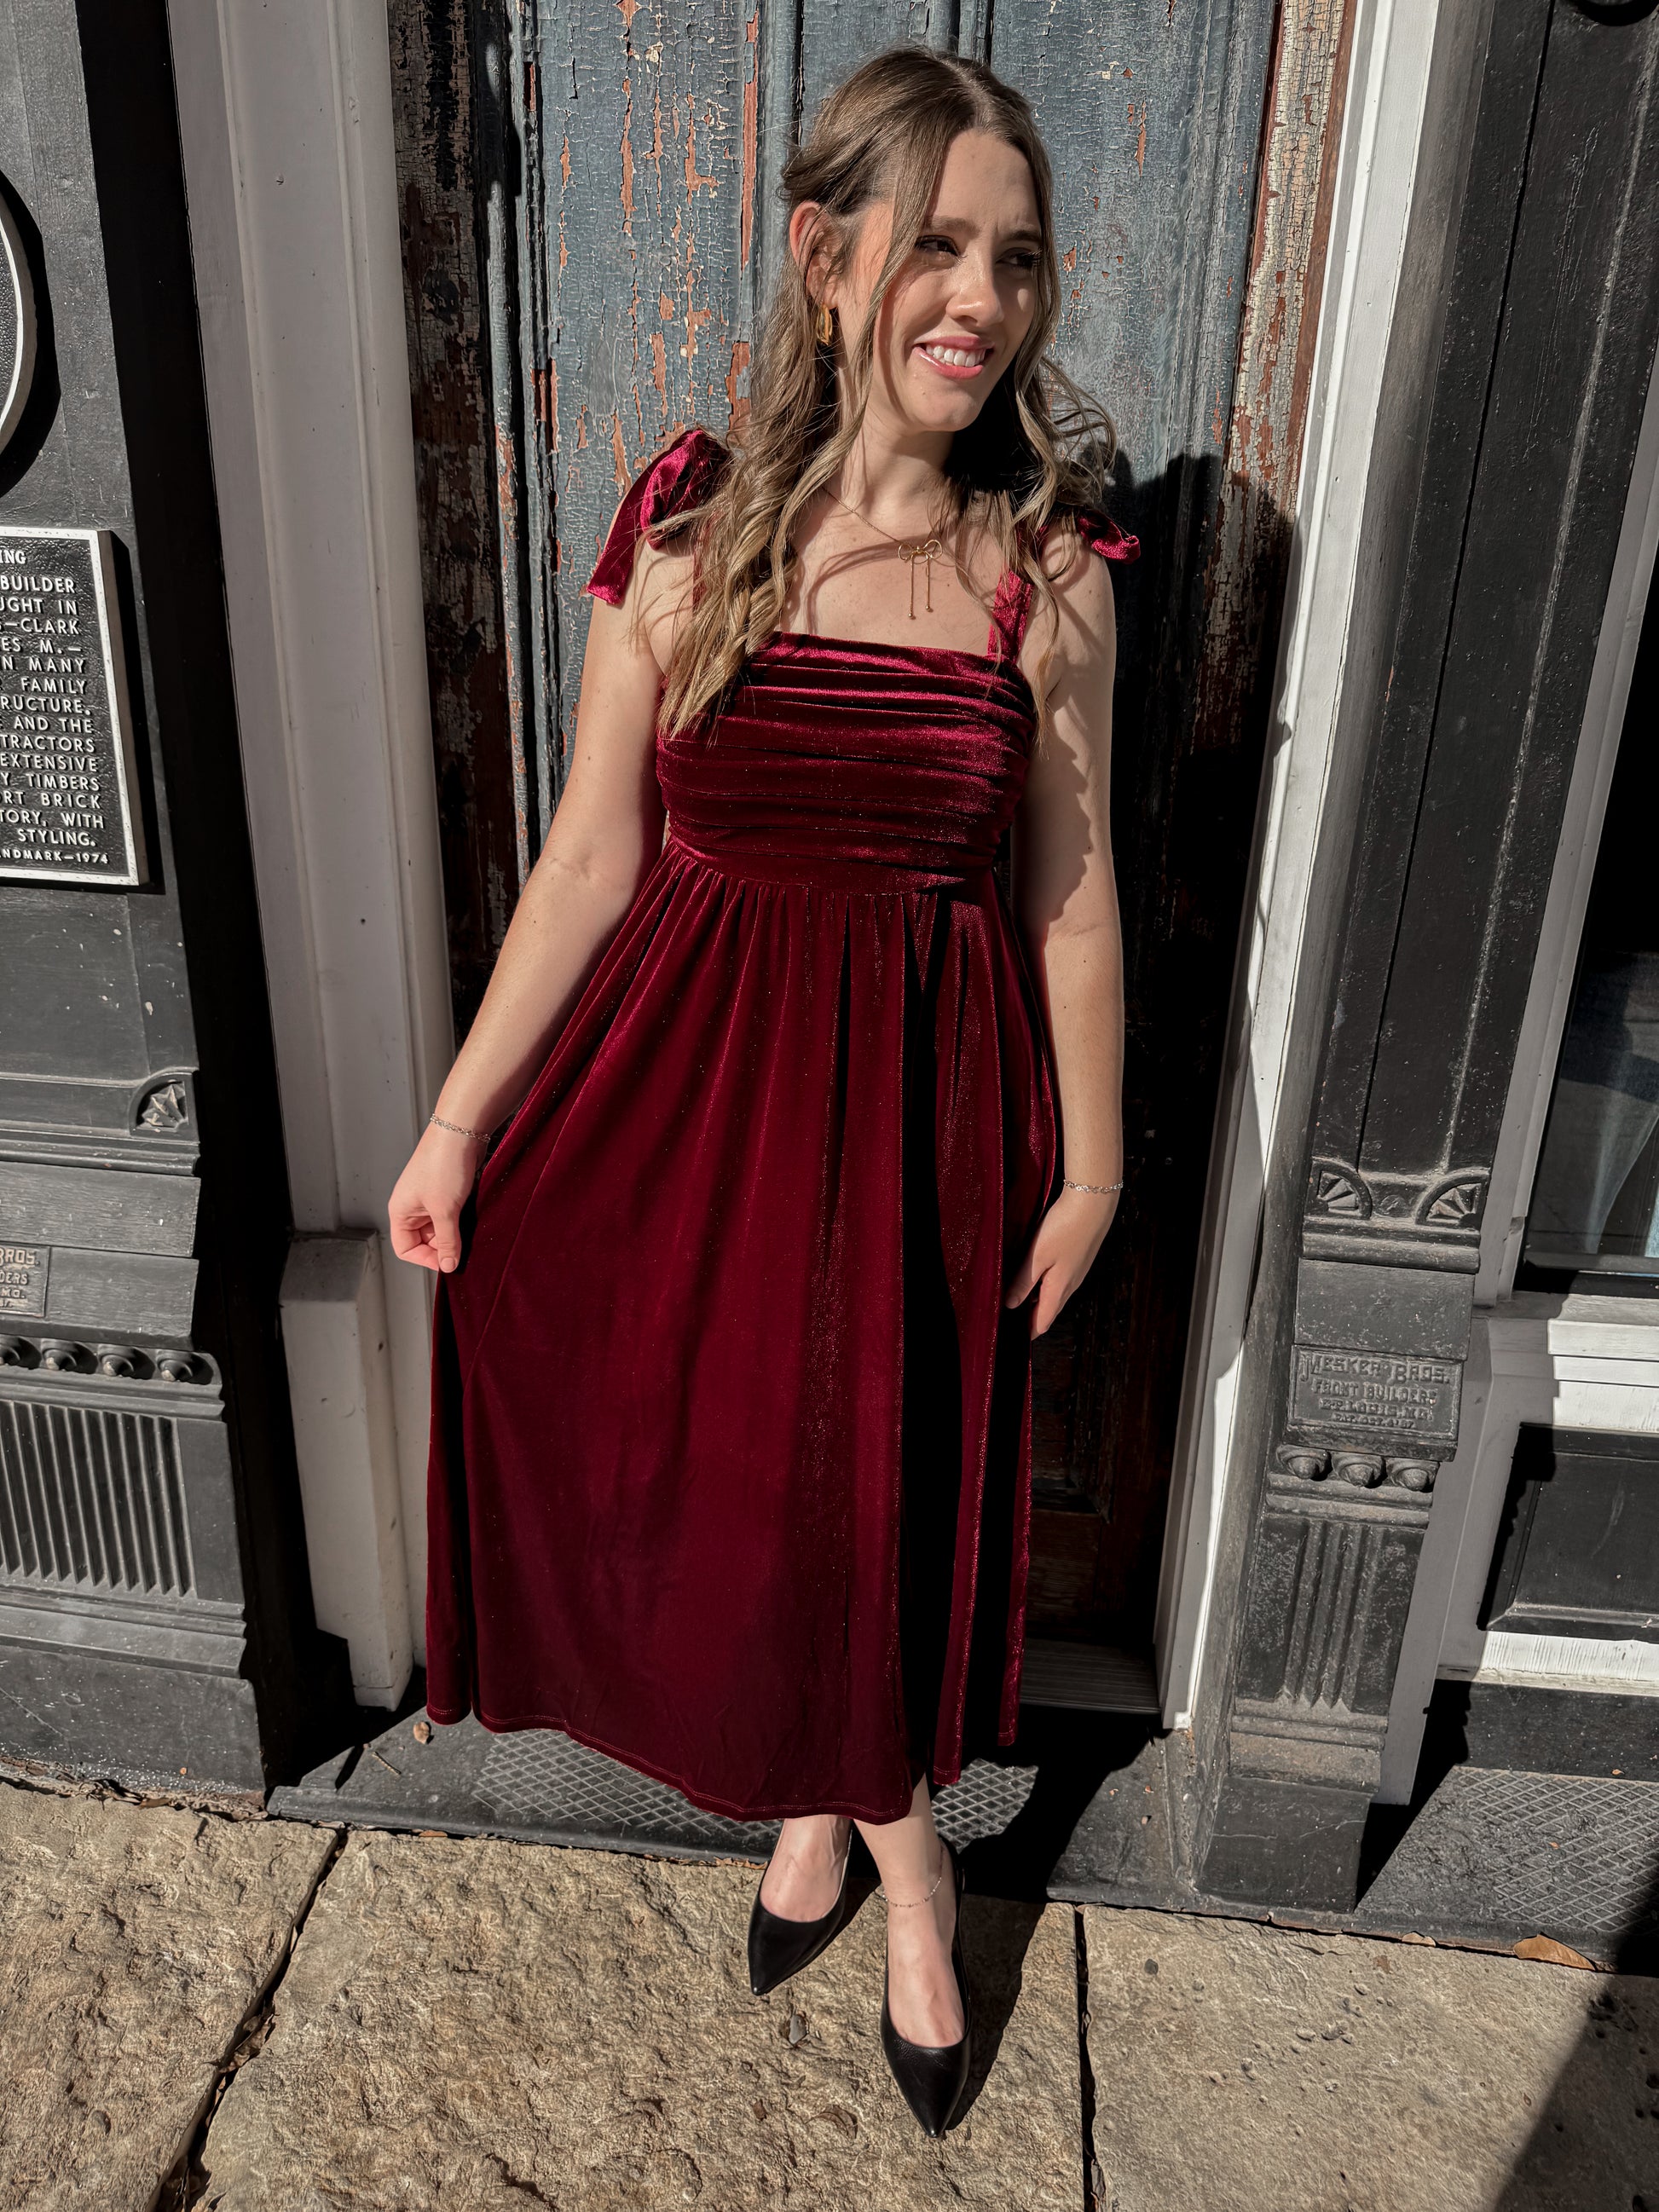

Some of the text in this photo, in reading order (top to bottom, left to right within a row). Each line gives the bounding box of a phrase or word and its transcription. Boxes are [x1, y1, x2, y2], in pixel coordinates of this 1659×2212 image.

[0, 575, 75, 593] BUILDER
[58, 599, 78, 615] IN
[29, 657, 84, 673] MANY
[20, 677, 85, 694] FAMILY
[0, 695, 91, 715] RUCTURE.
[14, 716, 49, 731] AND
[58, 718, 92, 733] THE
[0, 734, 95, 753] TRACTORS
[0, 753, 97, 772] EXTENSIVE
[26, 773, 100, 791] TIMBERS
[40, 792, 101, 809] BRICK
[61, 812, 104, 829] WITH
[17, 829, 95, 846] STYLING.
[1313, 1377, 1437, 1405] FRONT BUILDERS
